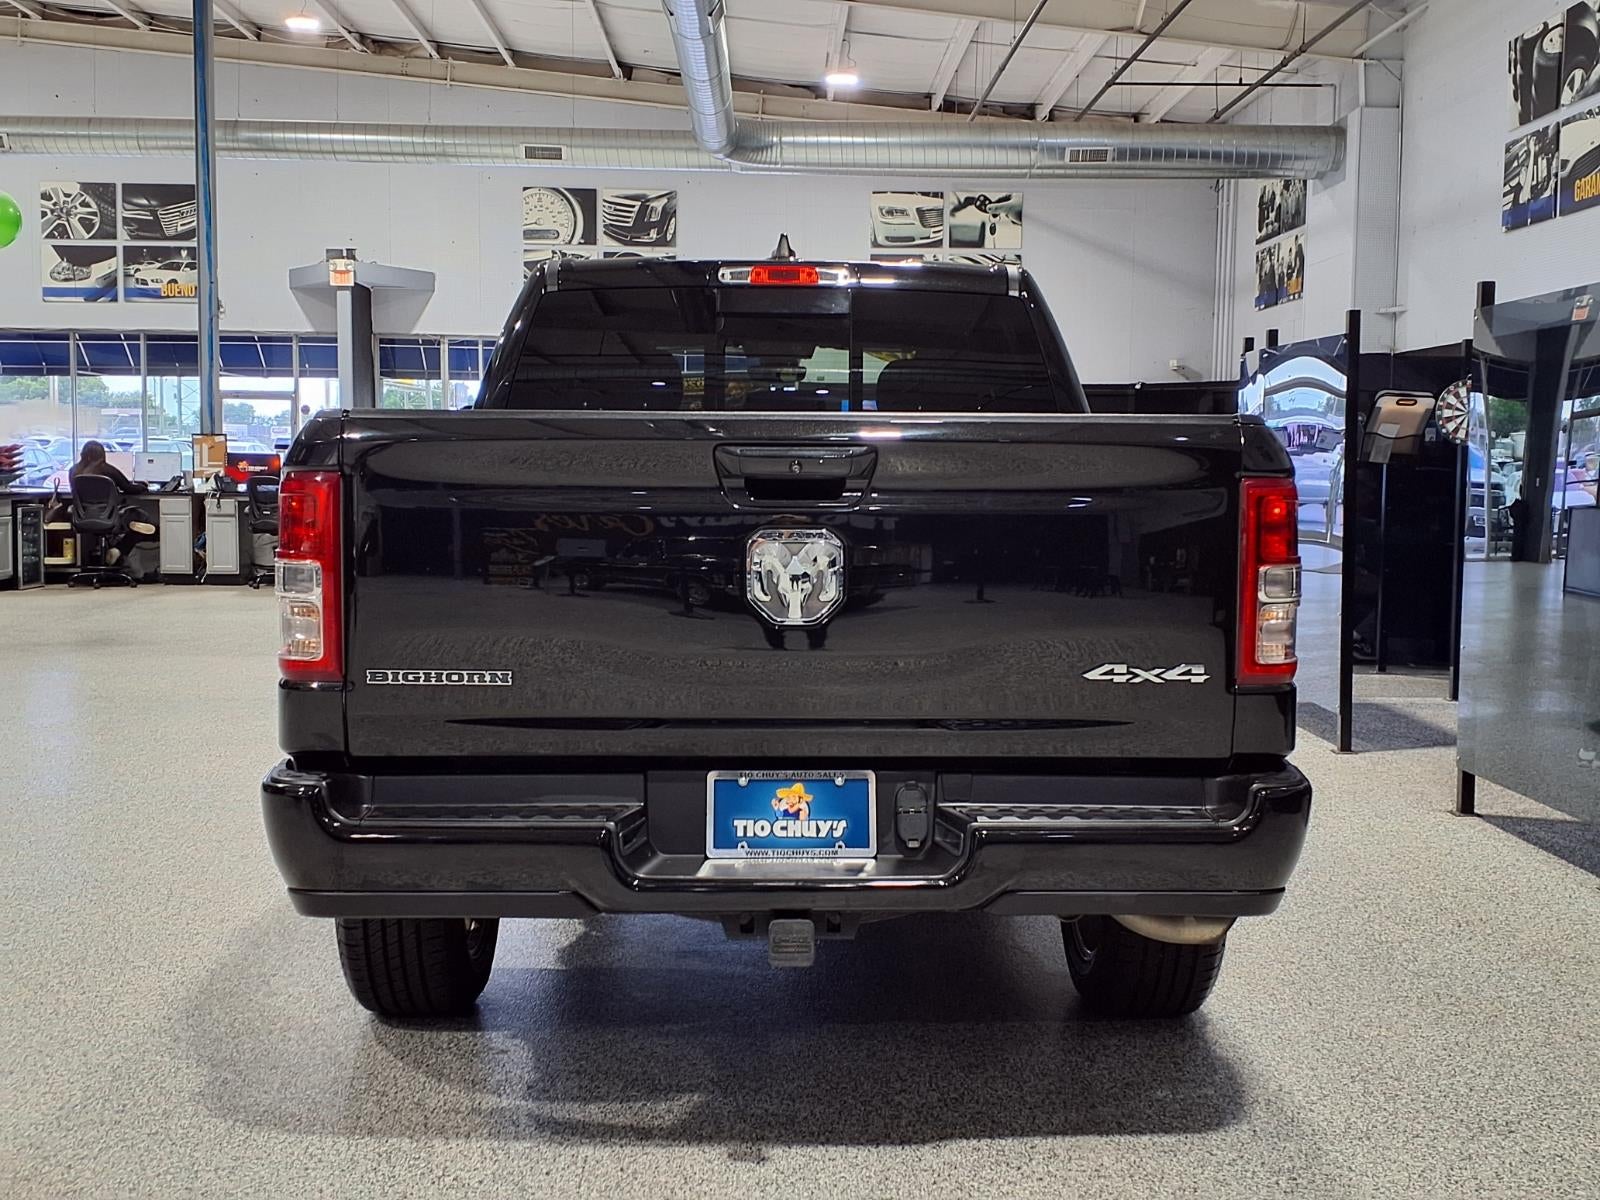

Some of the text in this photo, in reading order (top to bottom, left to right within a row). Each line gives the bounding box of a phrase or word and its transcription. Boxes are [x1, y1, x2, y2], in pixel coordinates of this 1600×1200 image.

[160, 281, 196, 297] BUENO
[366, 669, 513, 686] BIGHORN
[1081, 663, 1211, 683] 4x4
[791, 771, 815, 779] AUTO
